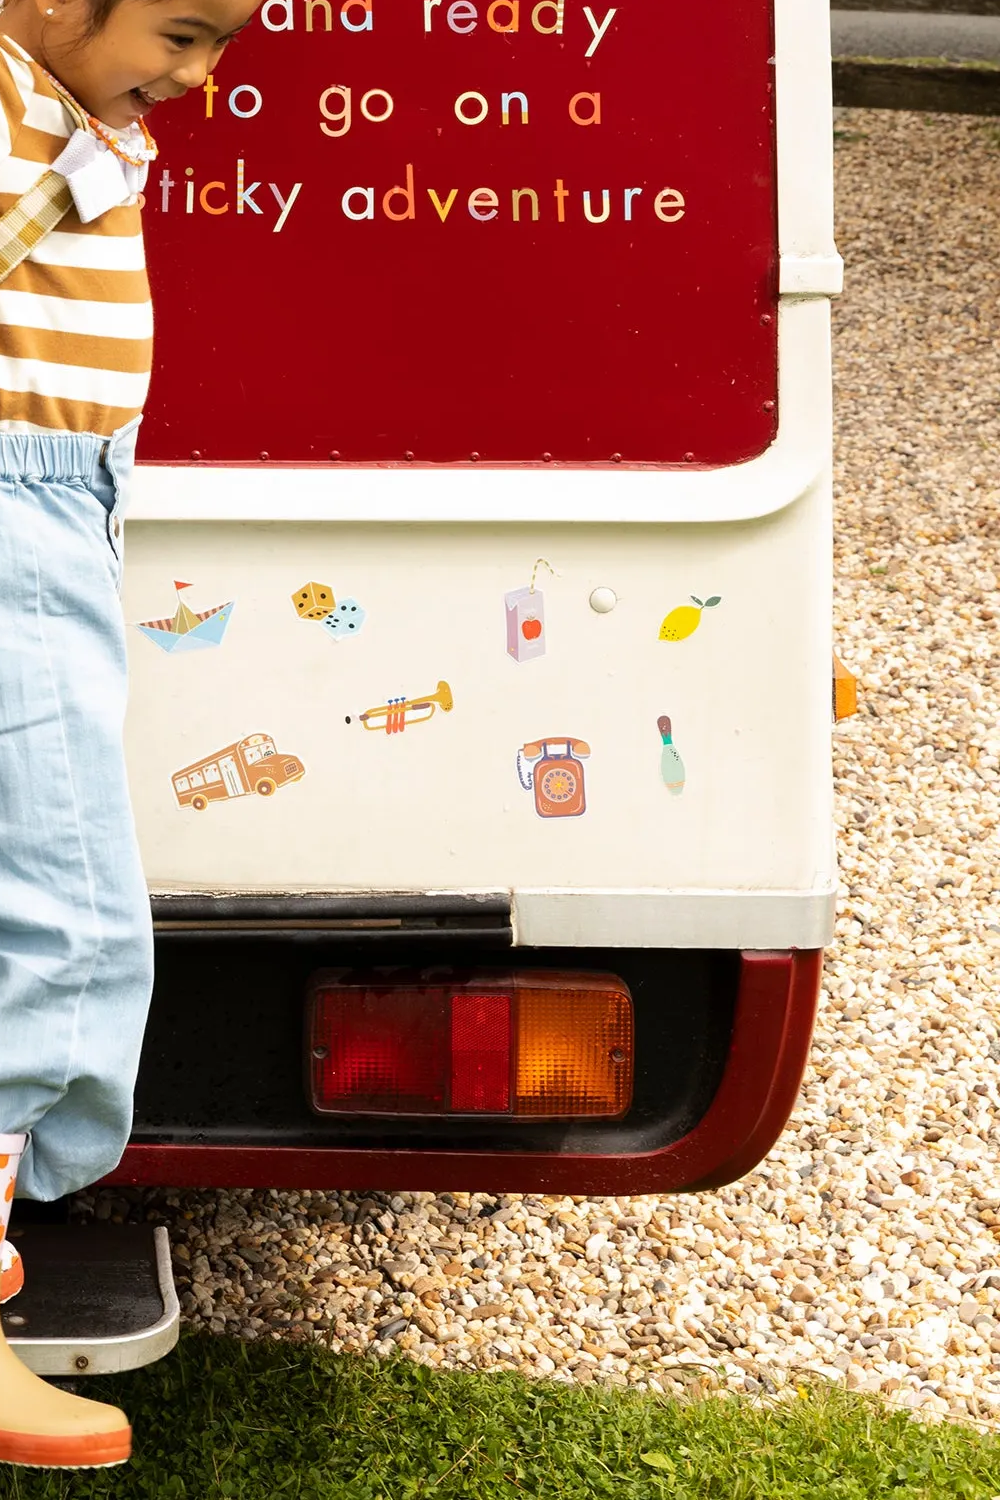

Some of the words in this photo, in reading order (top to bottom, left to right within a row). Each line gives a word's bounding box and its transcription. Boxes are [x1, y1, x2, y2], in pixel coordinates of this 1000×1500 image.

[203, 75, 263, 119] to
[319, 85, 394, 137] go
[454, 91, 530, 125] on
[568, 91, 601, 125] a
[138, 159, 302, 232] ticky
[341, 164, 686, 223] adventure
